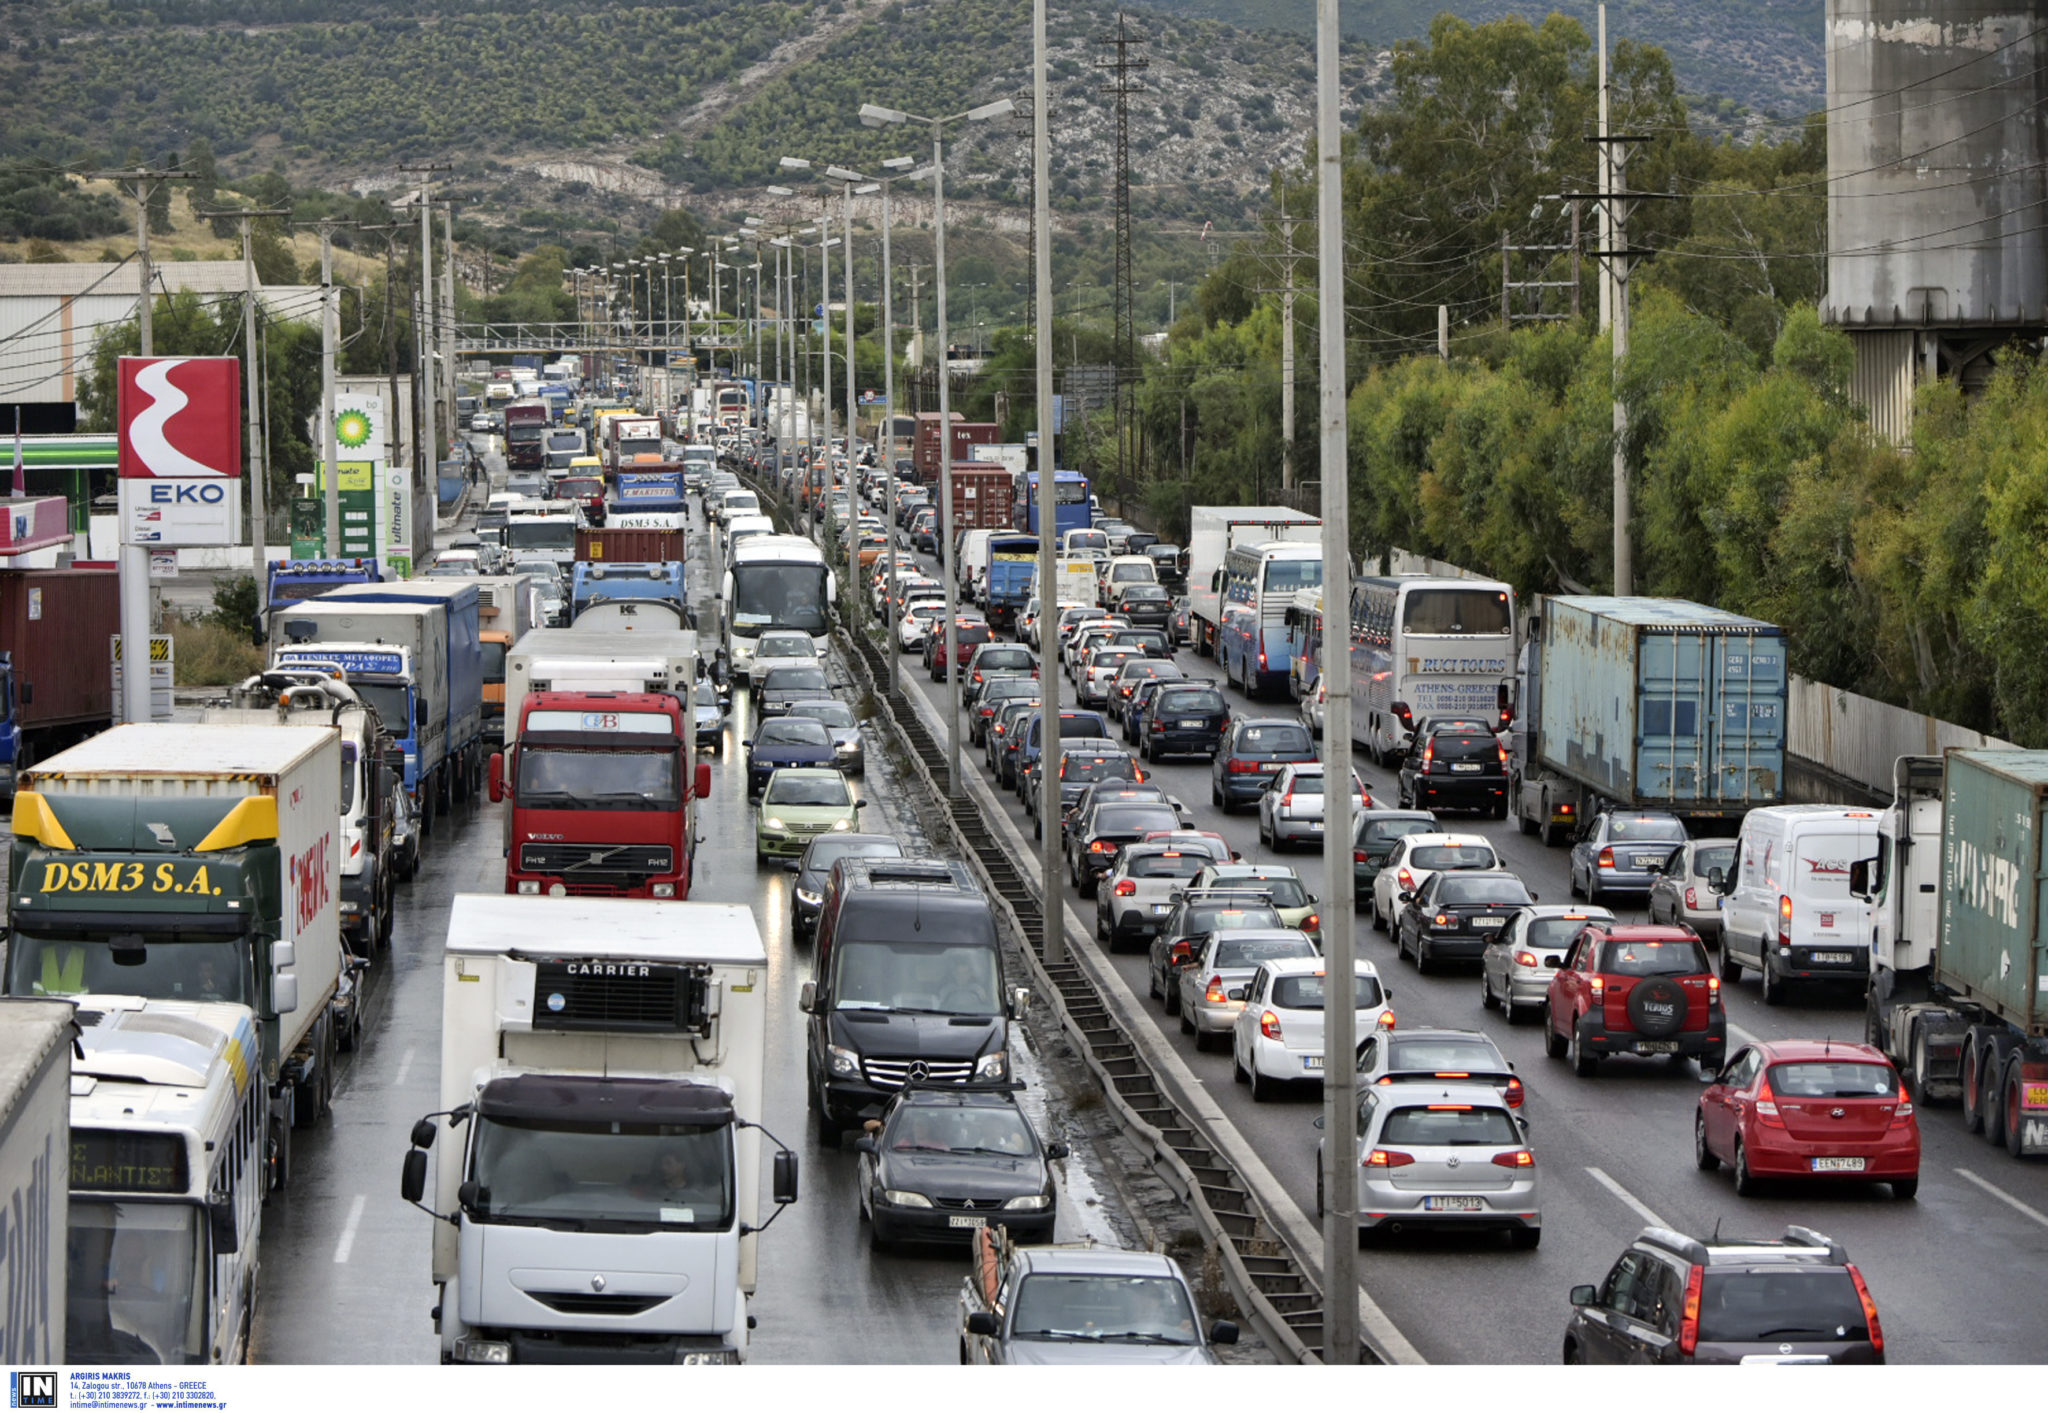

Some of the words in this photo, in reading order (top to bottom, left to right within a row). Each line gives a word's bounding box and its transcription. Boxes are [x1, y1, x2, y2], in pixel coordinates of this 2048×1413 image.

[151, 484, 224, 503] EKO
[392, 491, 402, 543] ultimate
[620, 519, 650, 528] DSM3
[1460, 659, 1505, 673] TOURS
[1816, 859, 1847, 870] ACS
[40, 862, 145, 893] DSM3
[152, 863, 222, 896] S.A.
[567, 963, 650, 977] CARRIER
